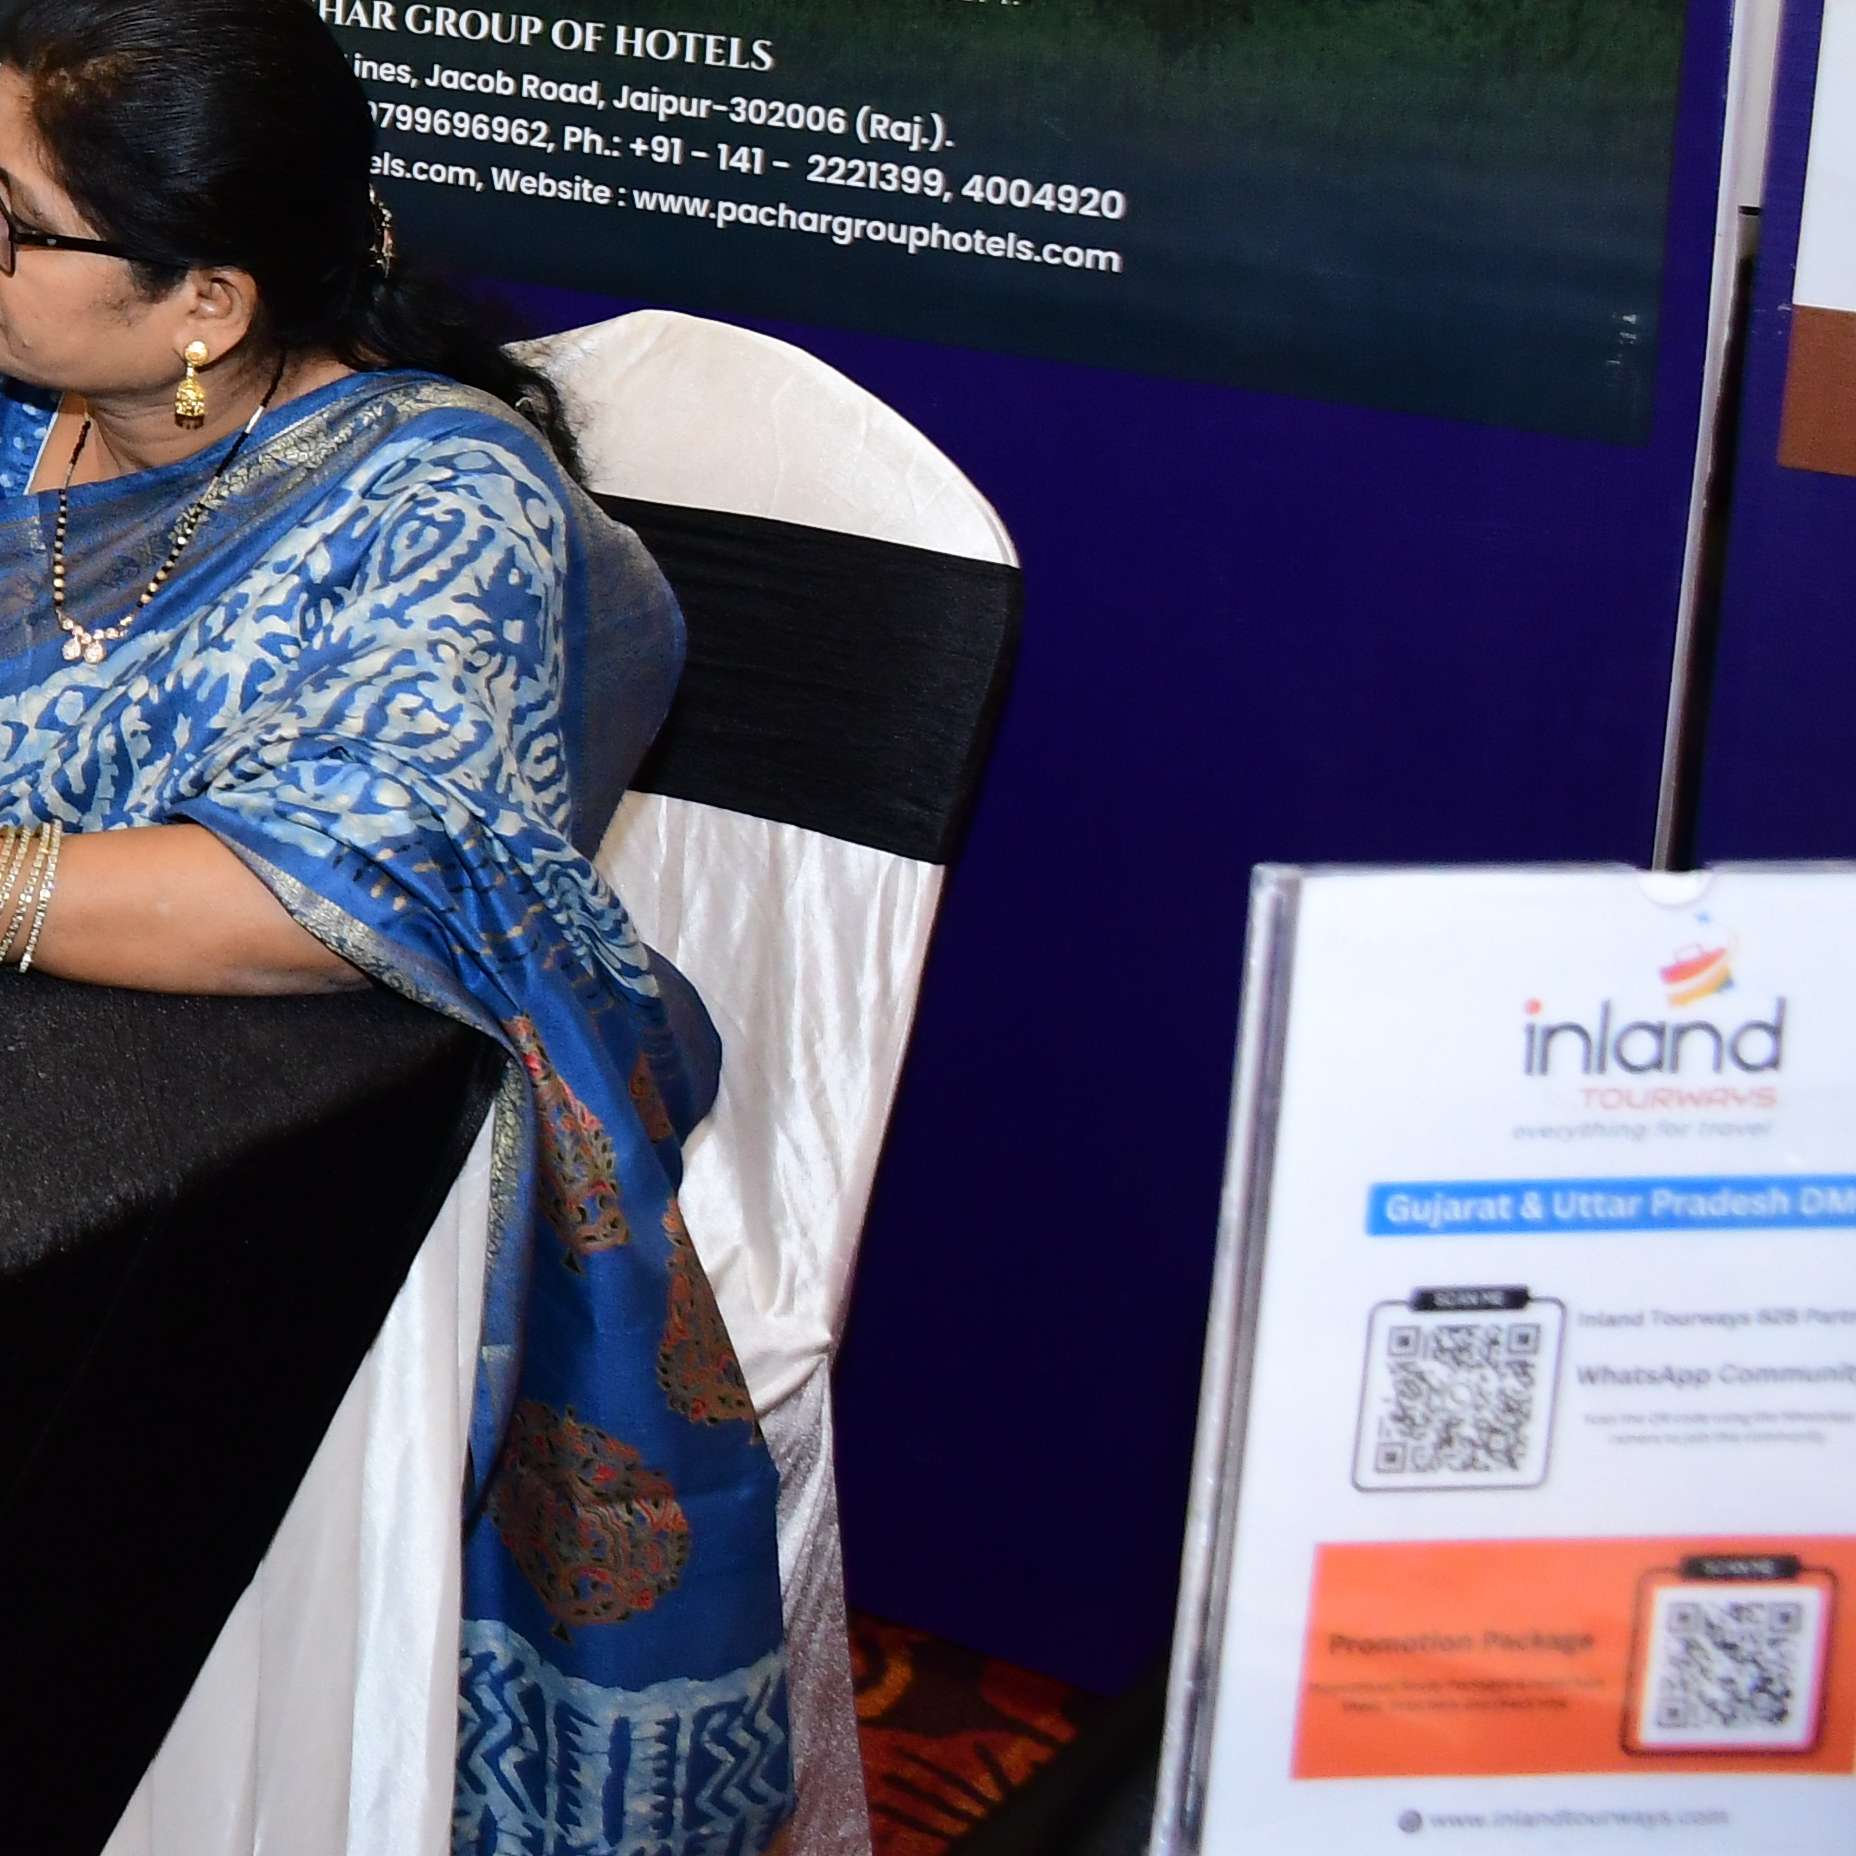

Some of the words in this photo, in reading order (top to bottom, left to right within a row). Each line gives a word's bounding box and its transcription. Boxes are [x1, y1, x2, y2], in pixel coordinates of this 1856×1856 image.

[404, 2, 544, 48] GROUP
[550, 18, 606, 54] OF
[615, 23, 775, 72] HOTELS
[344, 52, 420, 89] ines,
[425, 63, 517, 97] Jacob
[521, 73, 605, 111] Road,
[612, 84, 848, 137] Jaipur-302006
[855, 105, 956, 152] (Raj.).
[368, 100, 556, 152] 799696962,
[562, 127, 622, 159] Ph.:
[629, 136, 684, 167] +91
[716, 143, 765, 176] 141
[805, 153, 954, 204] 2221399,
[960, 173, 1127, 222] 4004920
[369, 150, 486, 193] els.com,
[490, 166, 613, 207] Website
[632, 186, 1124, 274] www.pachargrouphotels.com
[1522, 994, 1788, 1077] inland
[1578, 1084, 1779, 1111] TOURWAYS
[1511, 1119, 1649, 1143] everything
[1653, 1118, 1693, 1140] for
[1696, 1118, 1773, 1139] travel
[1385, 1192, 1514, 1229] Gujarat
[1520, 1192, 1545, 1220] &
[1551, 1190, 1643, 1220] Uttar
[1650, 1188, 1790, 1220] Pradesh
[1797, 1186, 1856, 1217] DM
[1577, 1311, 1645, 1327] Inland
[1650, 1308, 1752, 1332] Tourways
[1576, 1363, 1712, 1389] WhatsApp
[1328, 1632, 1472, 1656] Promotion
[1484, 1630, 1595, 1656] Package
